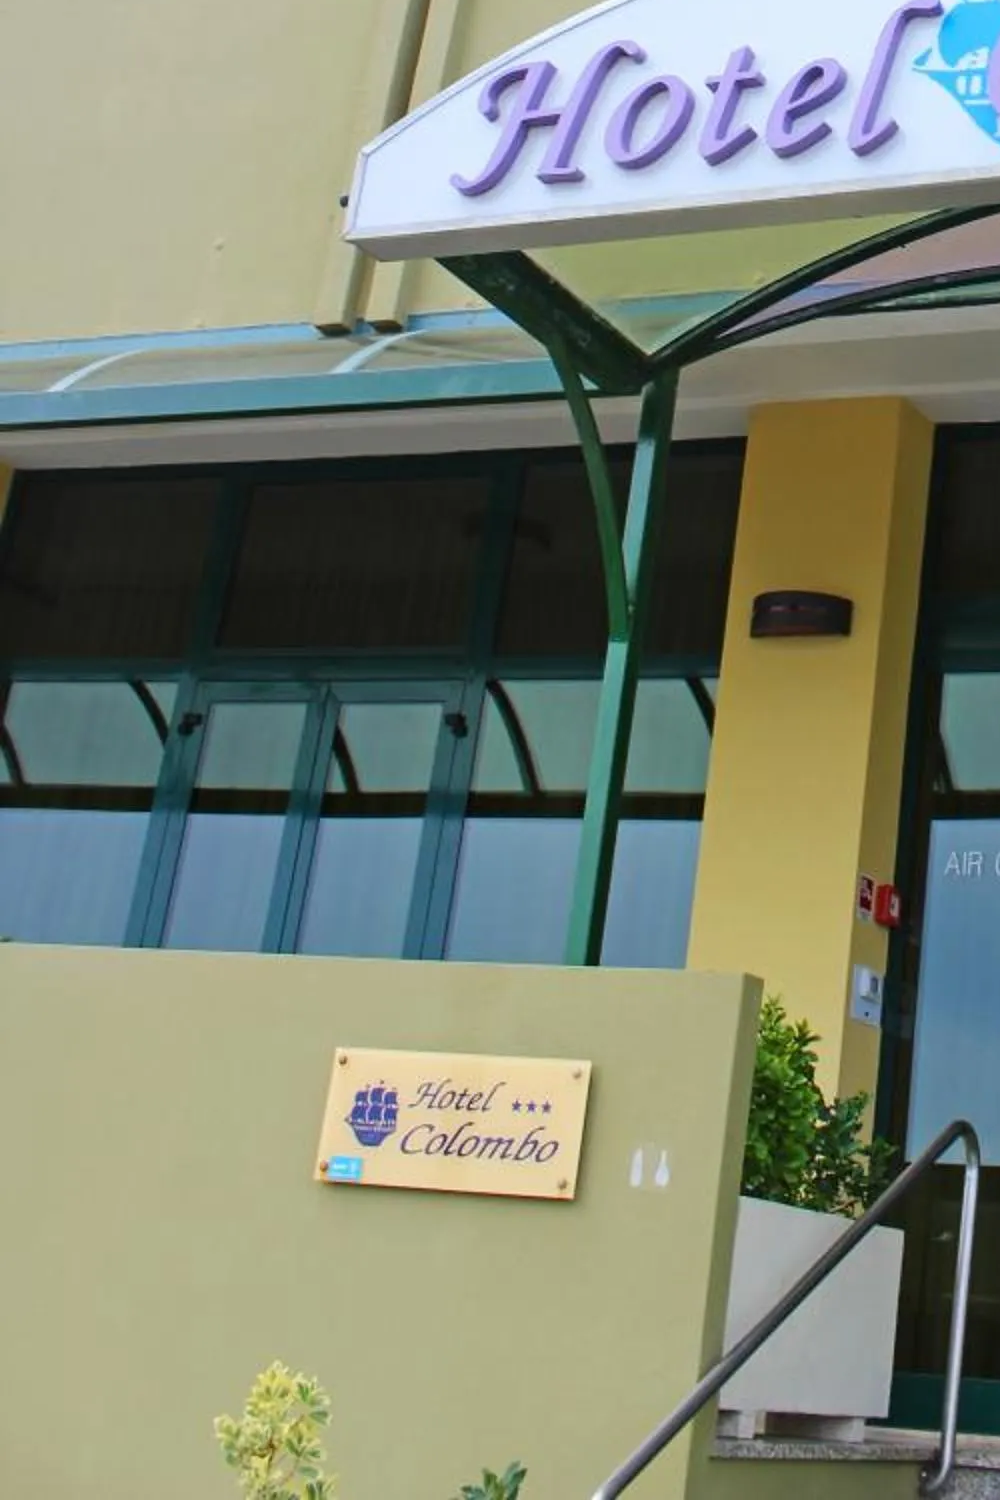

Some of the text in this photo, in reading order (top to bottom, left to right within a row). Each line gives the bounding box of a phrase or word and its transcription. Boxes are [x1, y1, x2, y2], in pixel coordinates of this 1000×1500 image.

[943, 851, 983, 877] AIR
[408, 1078, 507, 1113] Hotel
[400, 1121, 560, 1163] Colombo
